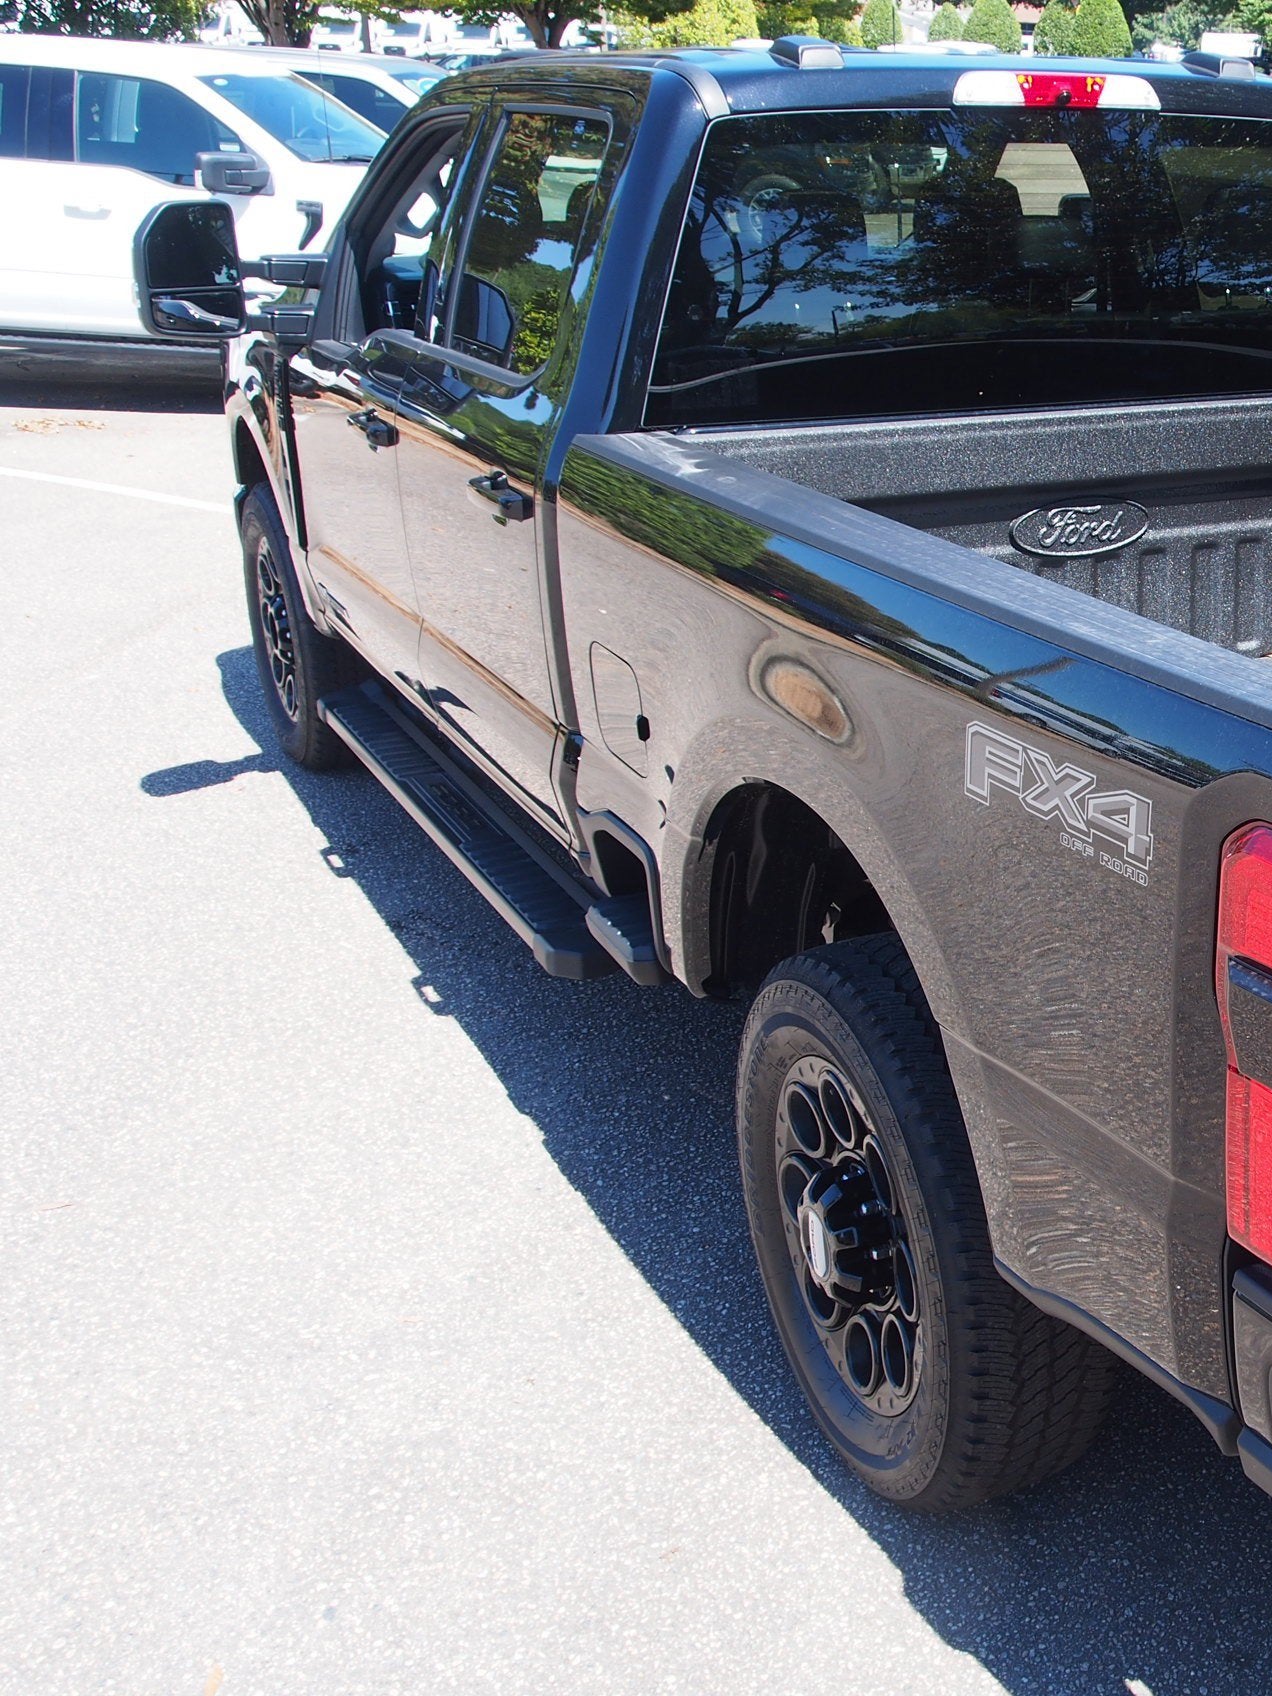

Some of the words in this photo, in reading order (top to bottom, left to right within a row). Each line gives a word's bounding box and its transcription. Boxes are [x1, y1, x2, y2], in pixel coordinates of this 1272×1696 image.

[1039, 504, 1123, 548] Ford
[964, 720, 1154, 870] FX4
[1060, 832, 1093, 857] OFF
[1099, 851, 1148, 887] ROAD
